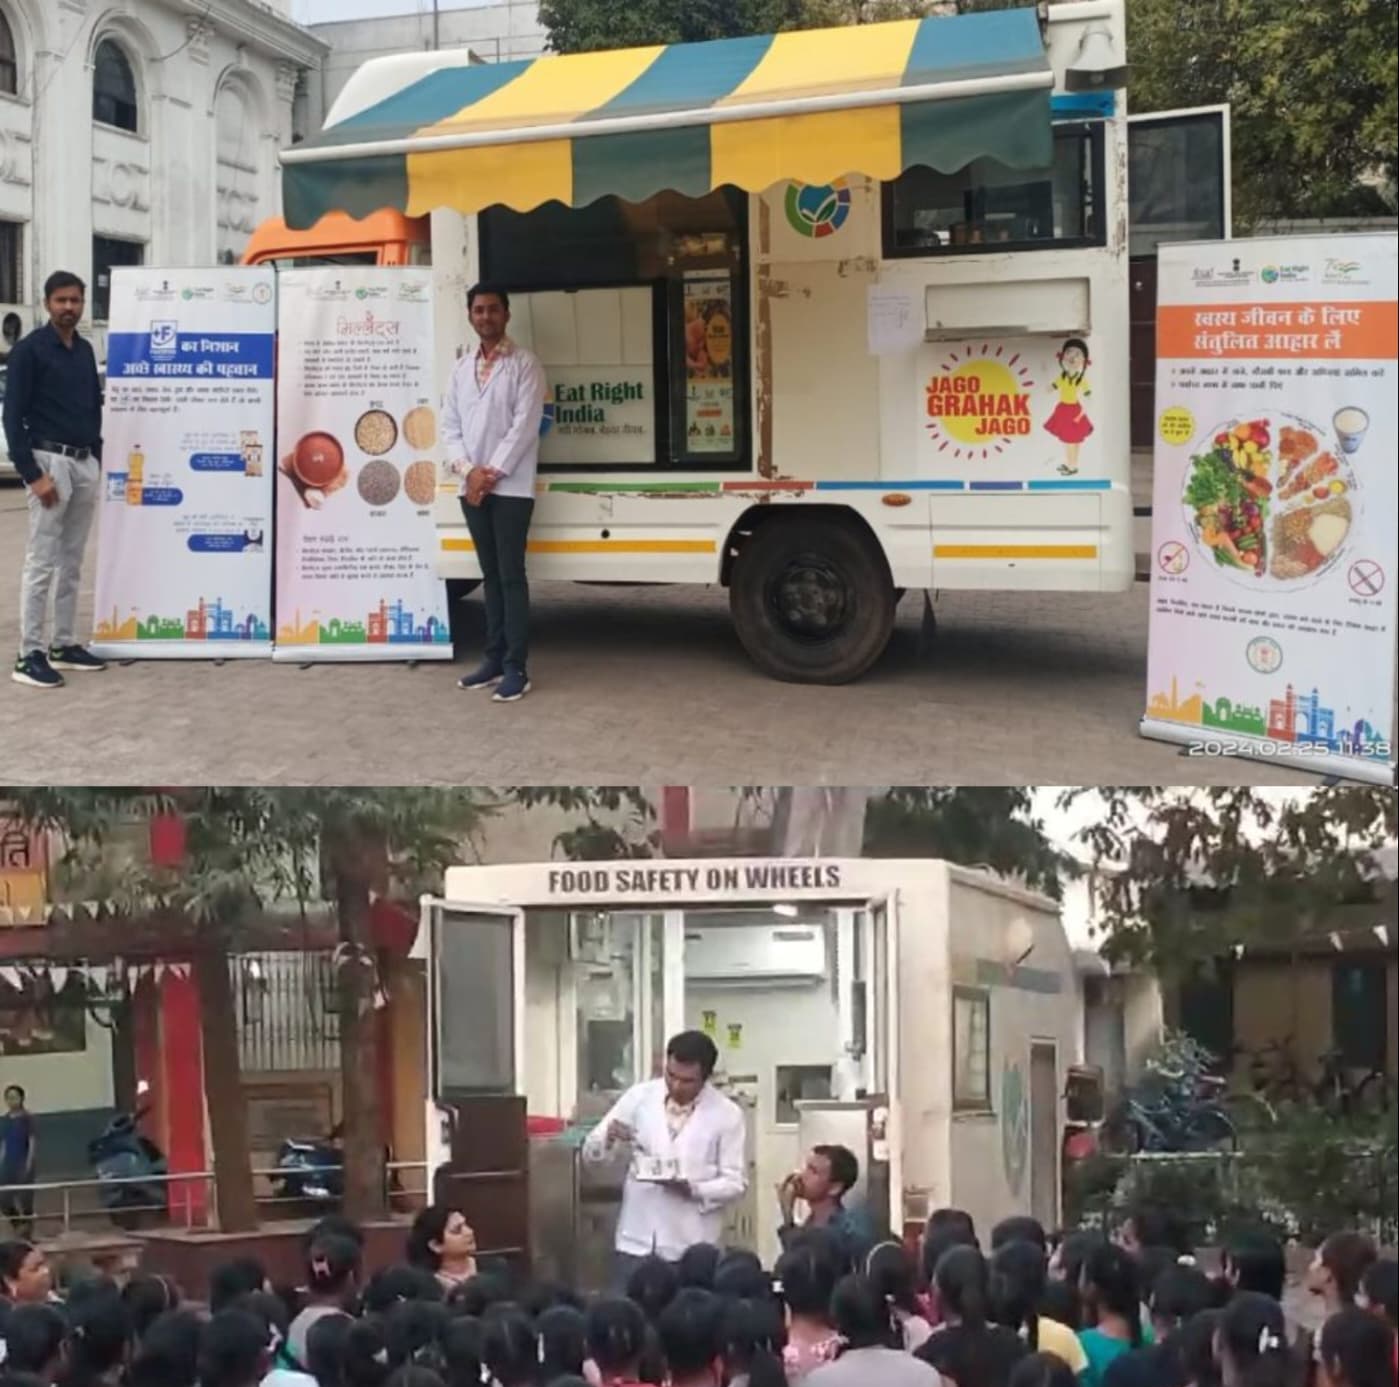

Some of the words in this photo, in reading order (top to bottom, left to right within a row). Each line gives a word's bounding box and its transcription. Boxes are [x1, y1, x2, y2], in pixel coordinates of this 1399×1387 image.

[1241, 307, 1292, 327] जीवन
[1298, 306, 1315, 325] के
[1321, 305, 1361, 326] लिए
[181, 340, 197, 353] का
[1195, 330, 1258, 356] संतुलित
[1264, 332, 1318, 352] आहार
[196, 360, 213, 375] की
[555, 384, 585, 401] Eat
[591, 382, 643, 405] Right
[926, 376, 980, 393] JAGO
[556, 404, 604, 423] India
[927, 394, 1030, 416] GRAHAK
[975, 418, 1031, 435] JAGO
[549, 870, 609, 893] FOOD
[616, 868, 699, 892] SAFETY
[706, 867, 739, 889] ON
[746, 865, 840, 889] WHEELS
